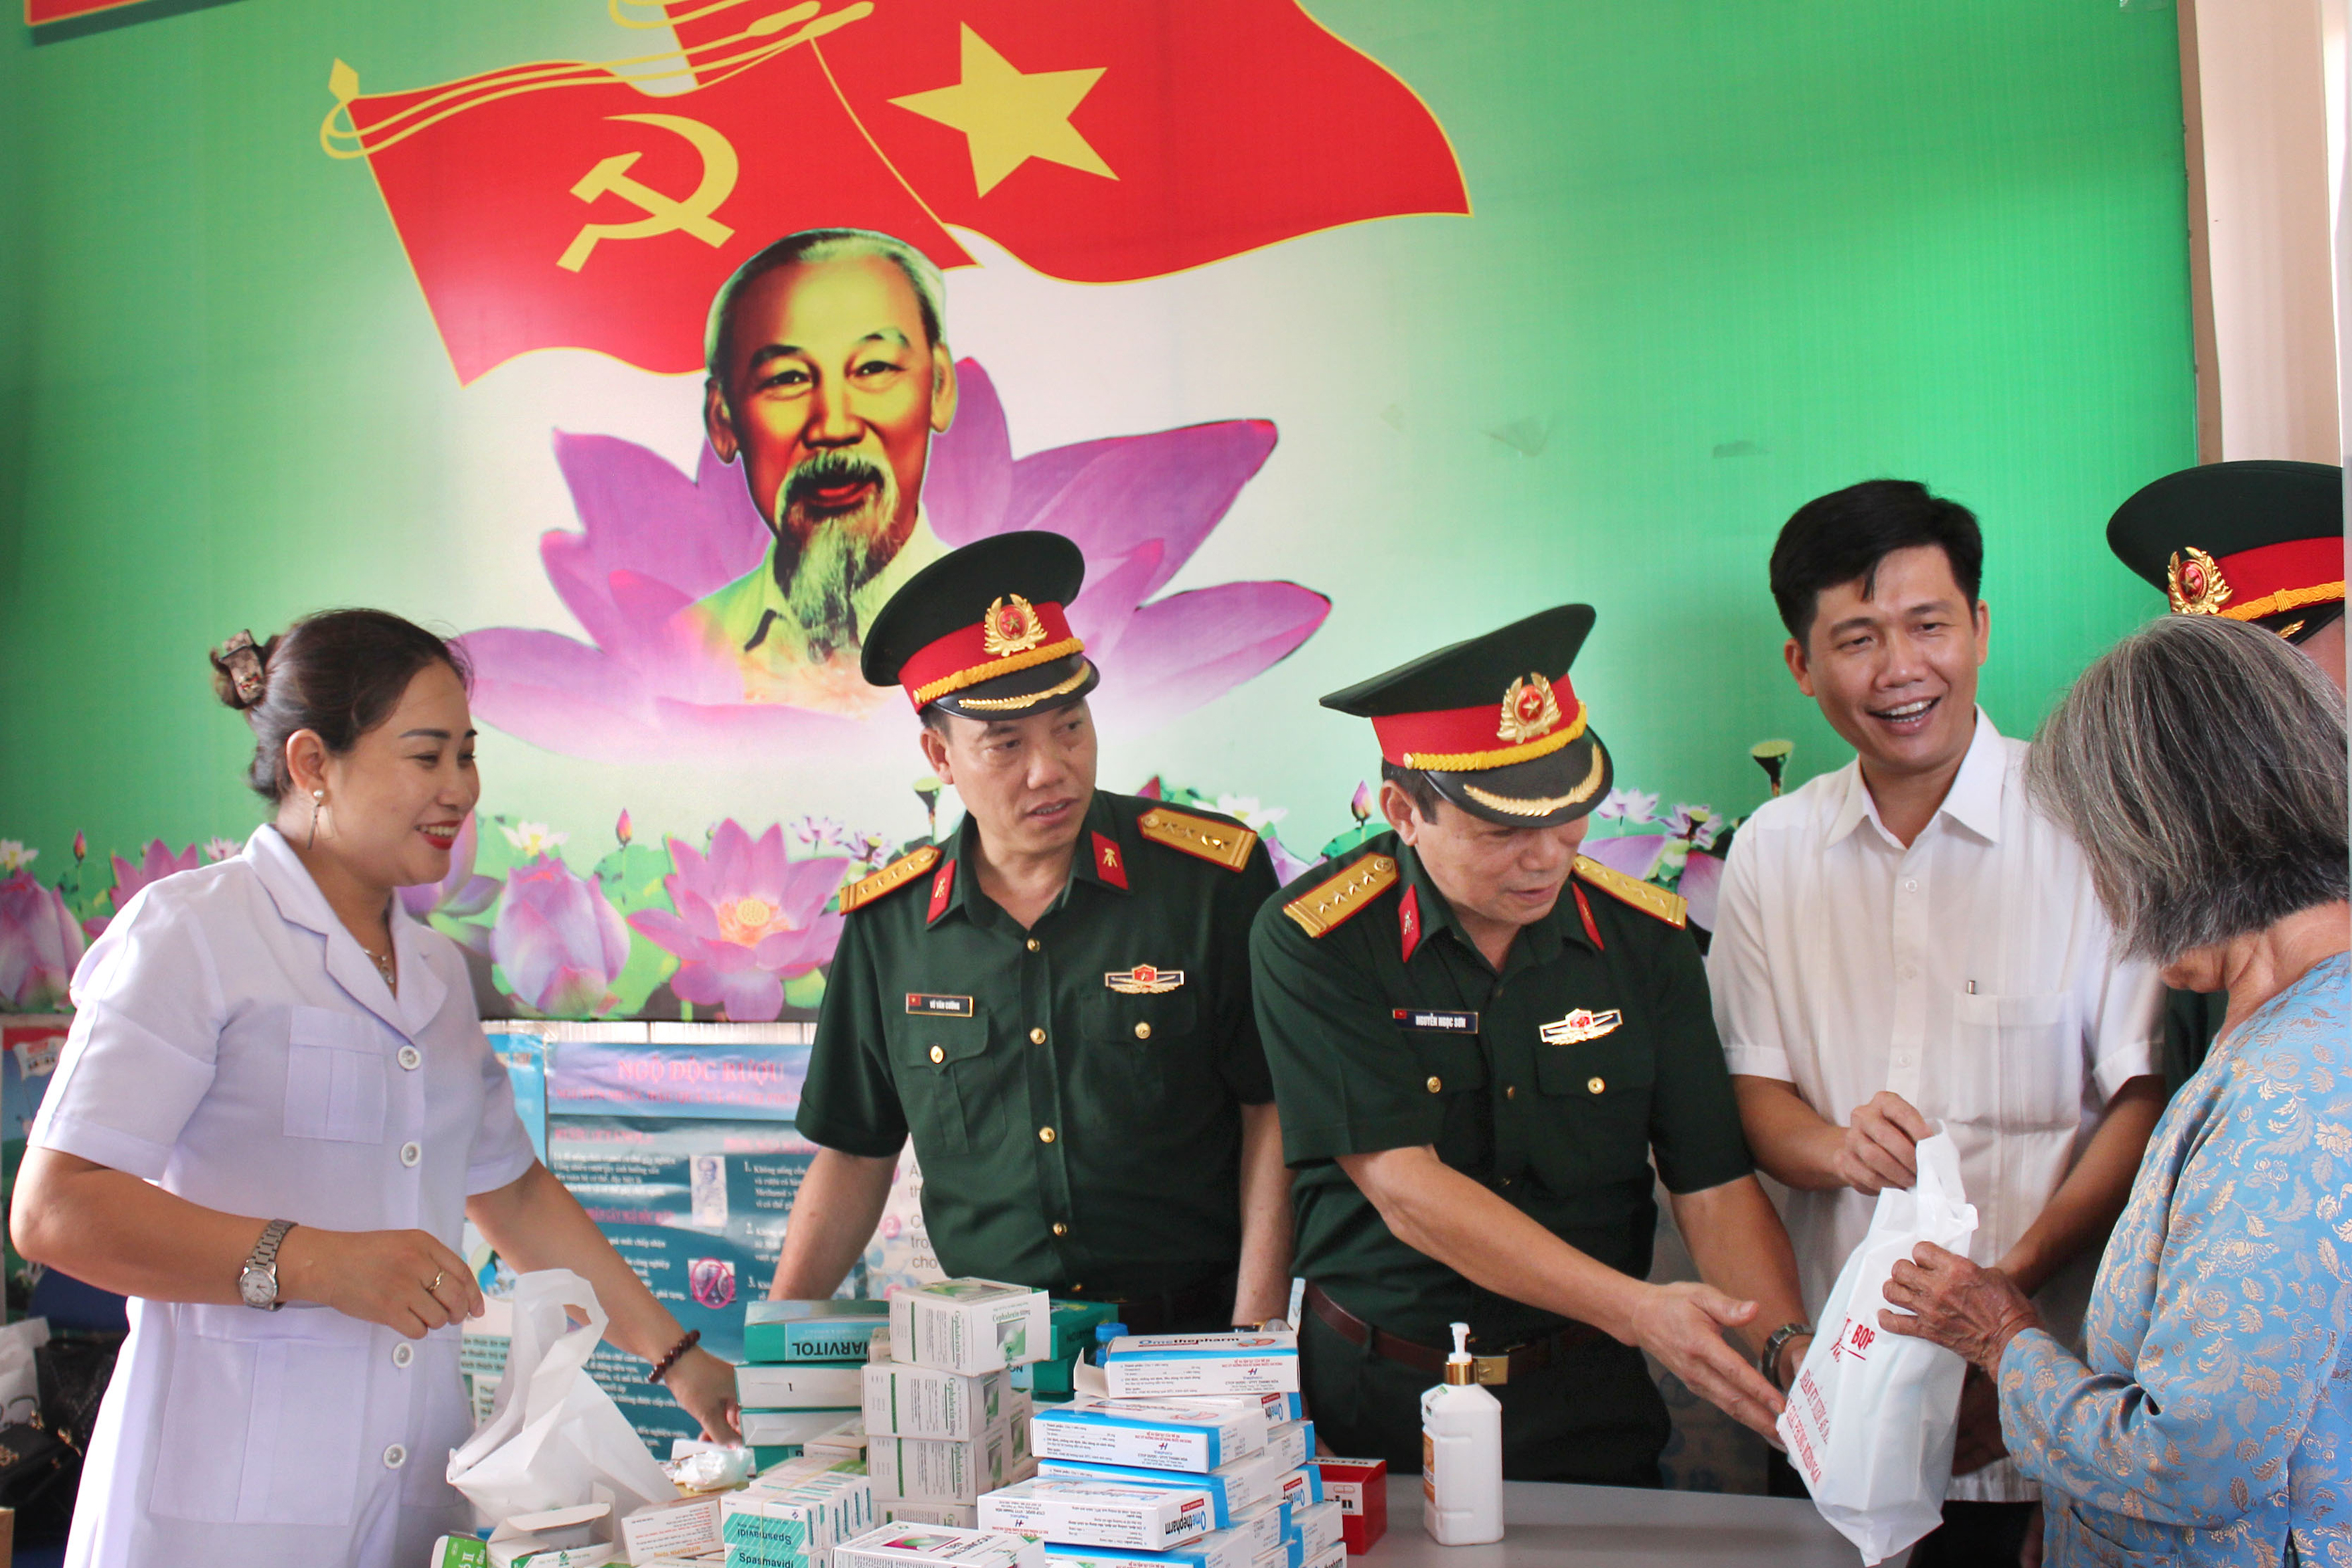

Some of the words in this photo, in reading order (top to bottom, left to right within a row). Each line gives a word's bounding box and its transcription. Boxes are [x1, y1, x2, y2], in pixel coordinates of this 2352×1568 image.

[1438, 1016, 1453, 1029] NGỌC
[618, 1056, 664, 1084] NGỘ
[722, 1059, 783, 1086] RƯỢU
[911, 1235, 929, 1249] tro
[1851, 1324, 1875, 1350] BQP
[1165, 1510, 1206, 1535] Omethepharm
[738, 1528, 792, 1545] Spasmavidi
